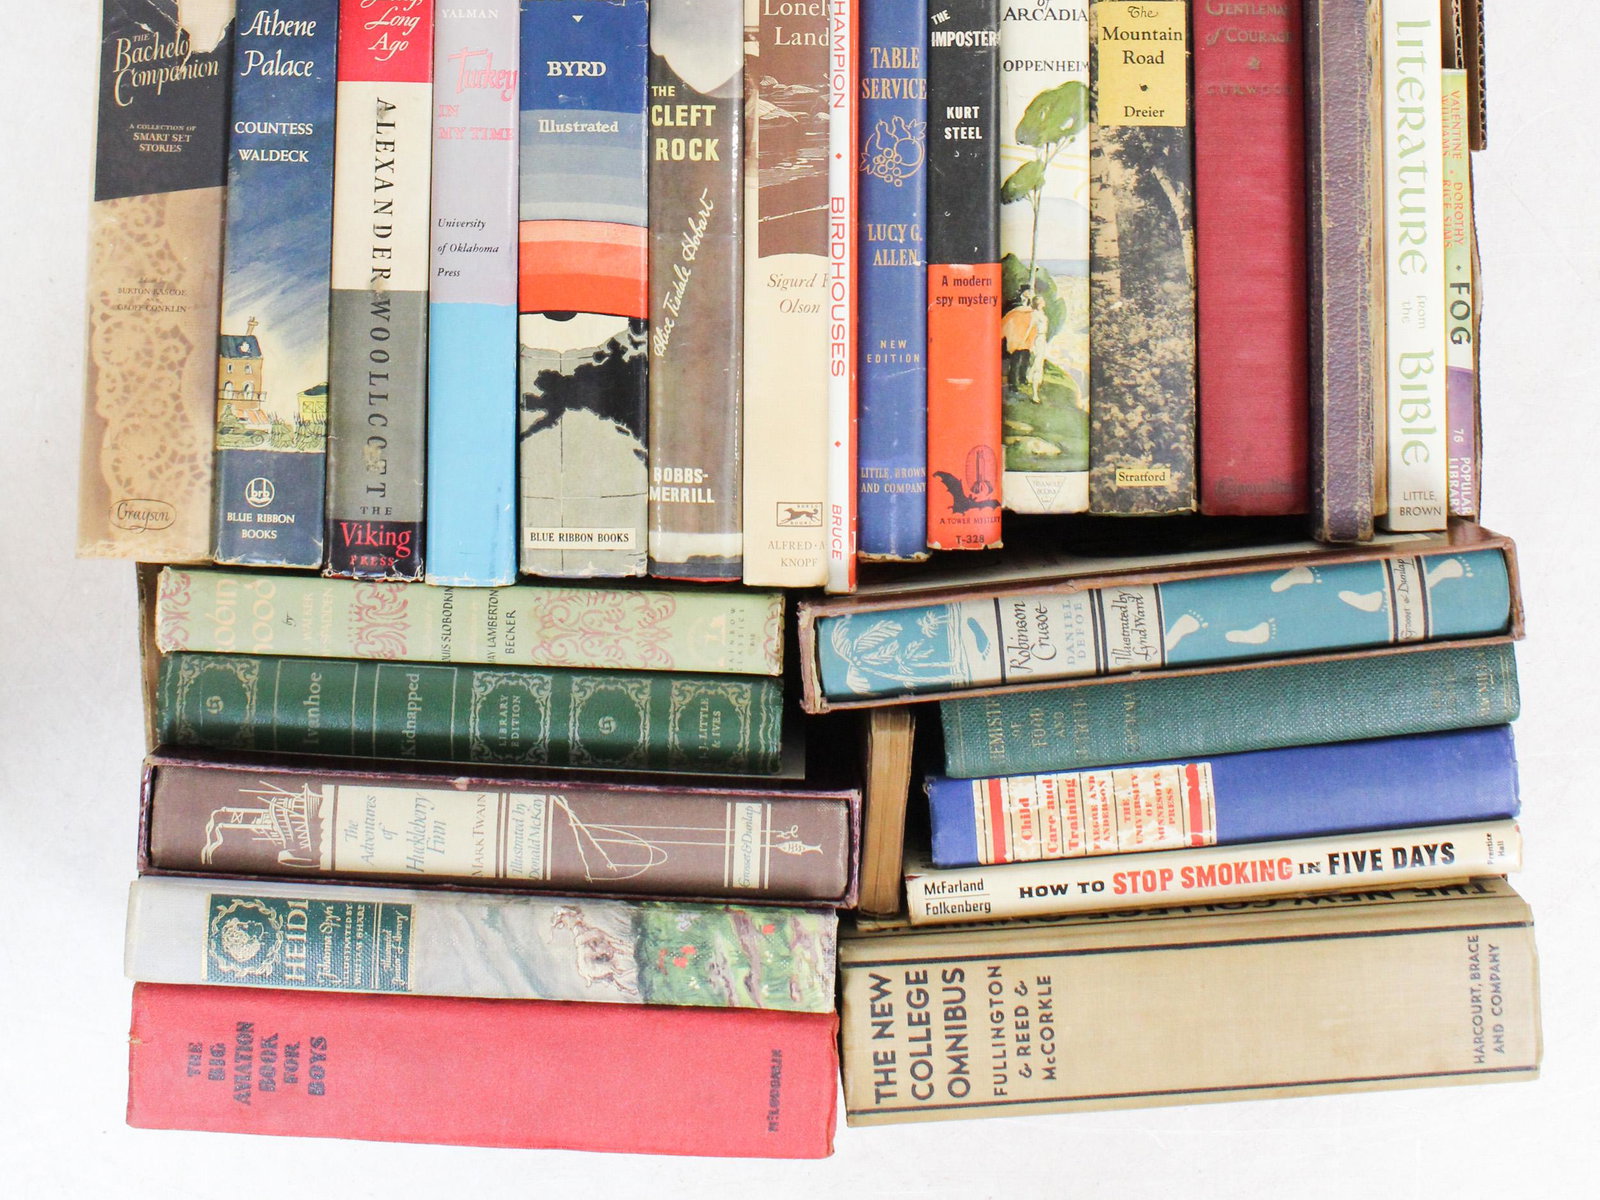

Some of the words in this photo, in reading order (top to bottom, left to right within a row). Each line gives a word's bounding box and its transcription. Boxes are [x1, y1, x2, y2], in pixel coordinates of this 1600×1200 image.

[240, 9, 317, 37] Athene
[364, 6, 421, 36] Long
[931, 9, 951, 26] THE
[1103, 26, 1183, 41] Mountain
[368, 32, 410, 62] Ago
[870, 46, 920, 69] TABLE
[1122, 50, 1165, 65] Road
[240, 49, 314, 77] Palace
[547, 61, 607, 77] BYRD
[114, 59, 219, 107] Companion
[652, 85, 675, 97] THE
[862, 78, 927, 100] SERVICE
[652, 105, 716, 127] CLEFT
[946, 106, 980, 119] KURT
[1124, 106, 1165, 118] Dreier
[235, 121, 313, 135] COUNTESS
[538, 119, 619, 133] Illustrated
[944, 126, 982, 140] STEEL
[239, 149, 309, 163] WALDECK
[655, 138, 720, 161] ROCK
[371, 97, 396, 282] ALEXANDER
[437, 218, 486, 232] University
[867, 224, 907, 242] LUCY
[910, 223, 923, 242] G.
[437, 244, 446, 256] of
[449, 244, 500, 253] Oklahoma
[437, 268, 461, 277] Press
[942, 276, 949, 287] A
[953, 275, 992, 286] modern
[831, 197, 845, 377] BIRDHOUSES
[936, 294, 954, 307] spy
[958, 293, 998, 307] mystery
[1450, 282, 1471, 345] FOG
[880, 340, 907, 349] NEW
[867, 353, 921, 363] EDITION
[1453, 429, 1464, 443] 76
[1118, 471, 1166, 482] Stratford
[650, 486, 715, 503] MERRILL
[227, 512, 252, 522] BLUE
[257, 513, 295, 523] RIBBON
[360, 506, 393, 515] THE
[1400, 506, 1442, 516] BROWN
[241, 529, 277, 539] BOOKS
[340, 521, 412, 559] Viking
[530, 532, 555, 542] BLUE
[558, 532, 593, 543] RIBBON
[597, 533, 629, 543] BOOKS
[831, 504, 842, 560] BRUCE
[956, 535, 985, 544] T-328
[350, 555, 395, 566] PRESS
[505, 610, 516, 654] BECKER
[1063, 600, 1075, 665] DANIEL
[1075, 602, 1087, 659] DEFOE
[360, 795, 377, 865] Adventures
[1019, 798, 1032, 840] Child
[406, 792, 434, 873] Huckleberry
[427, 820, 446, 855] Finn
[1019, 883, 1069, 899] HOW
[1077, 880, 1105, 894] TO
[1113, 867, 1175, 895] STOP
[1180, 857, 1293, 890] SMOKING
[1299, 861, 1321, 875] IN
[1328, 849, 1383, 875] FIVE
[1392, 842, 1455, 869] DAYS
[924, 878, 984, 895] McFarland
[925, 900, 991, 915] Folkenberg
[286, 900, 309, 982] HEIDI
[1488, 944, 1503, 1017] COMPANY
[869, 972, 895, 1040] NEW
[905, 969, 935, 1100] COLLEGE
[941, 967, 971, 1099] OMNIBUS
[987, 965, 1008, 1096] FULLINGTON
[1037, 975, 1057, 1080] McCORKLE
[1493, 1024, 1505, 1054] AND
[187, 1042, 202, 1077] THE
[234, 1021, 255, 1105] AVIATION
[259, 1033, 279, 1092] BOOK
[308, 1036, 327, 1096] BOYS
[873, 1050, 898, 1104] THE
